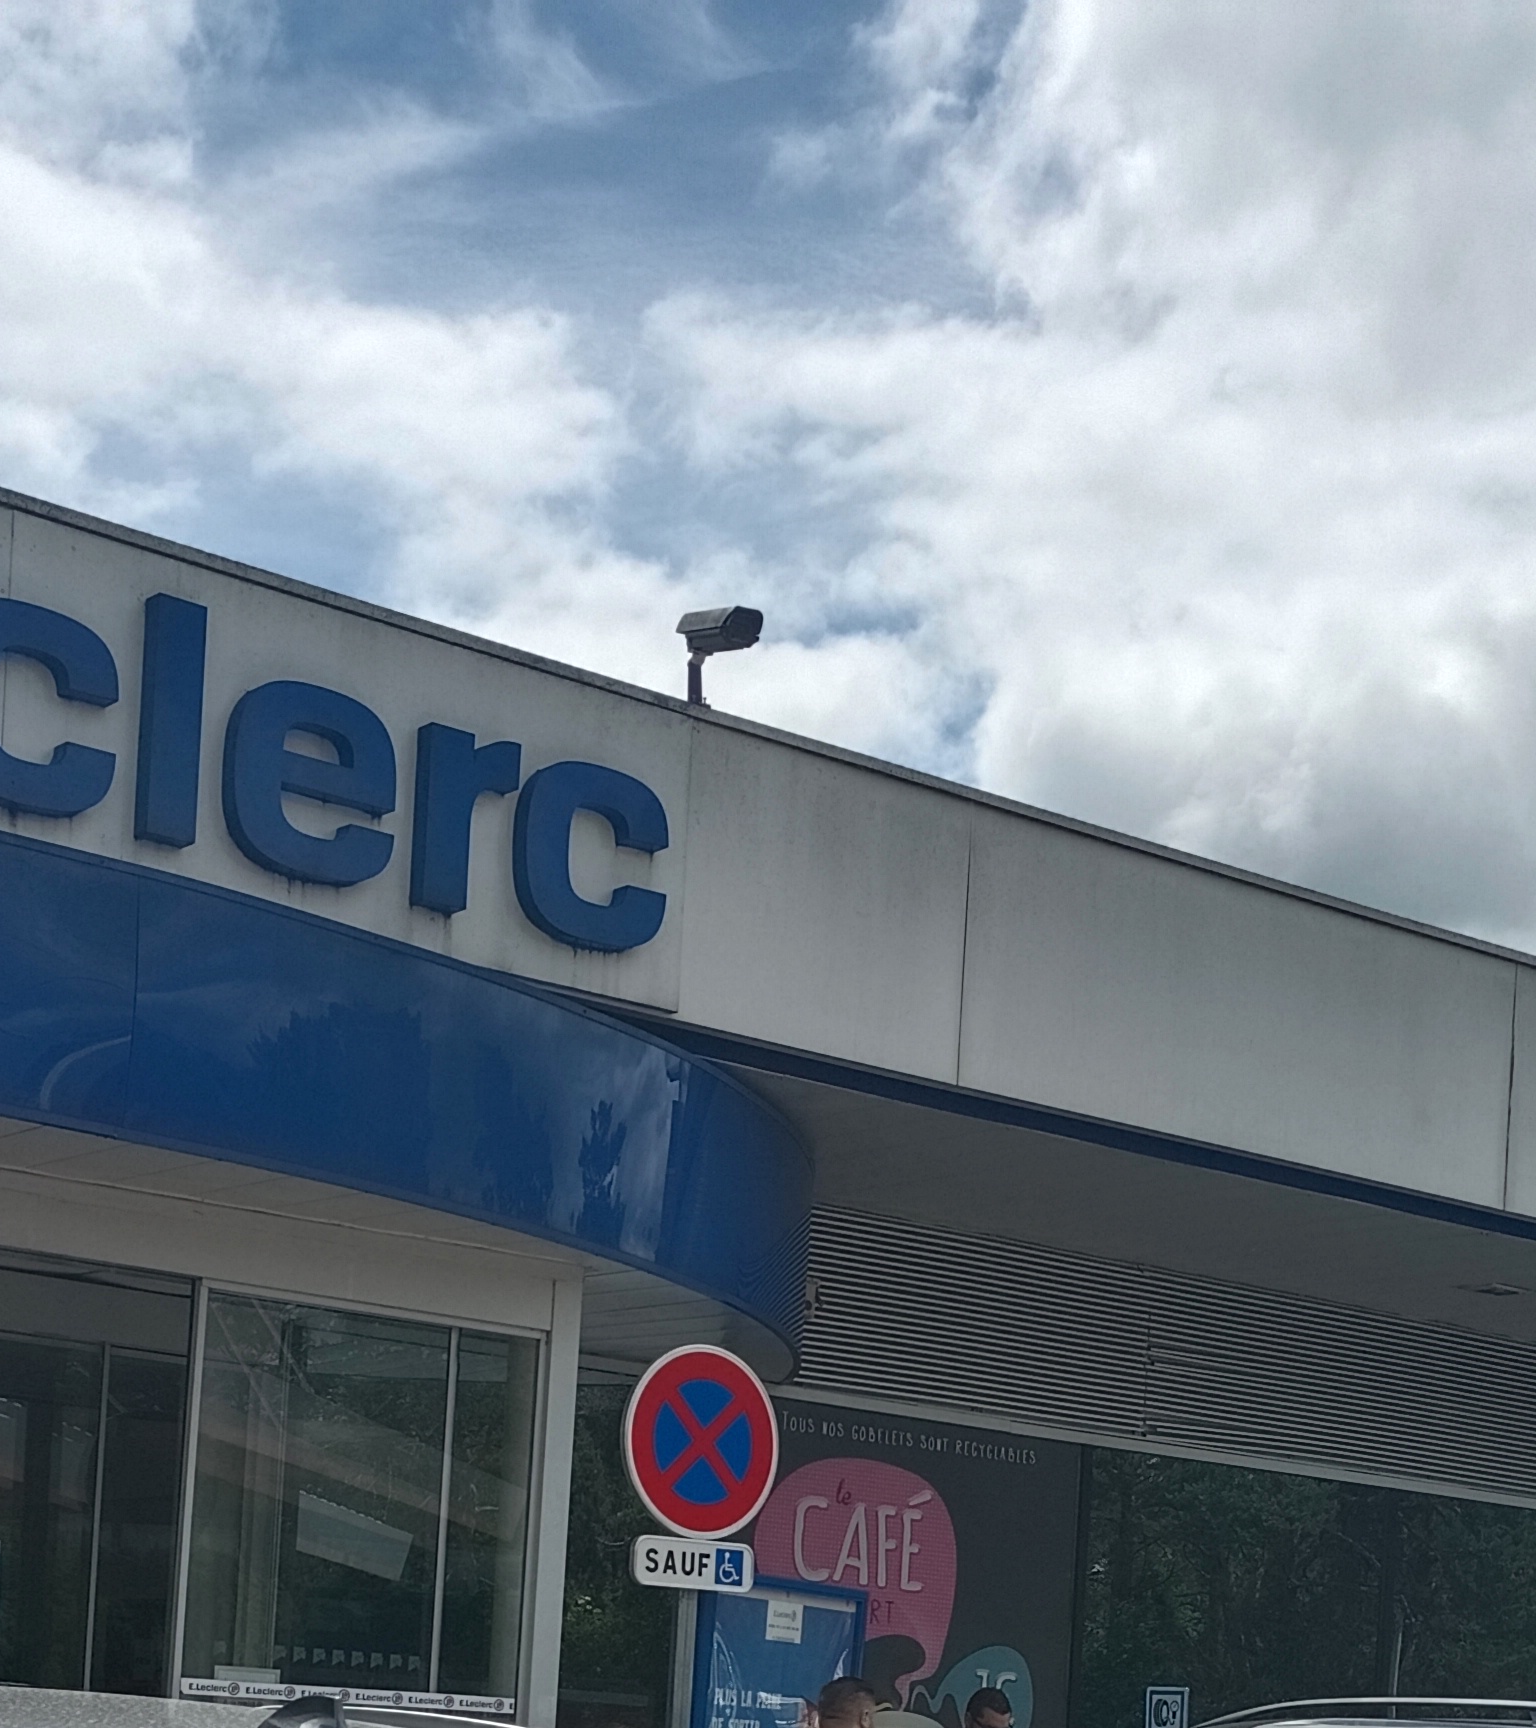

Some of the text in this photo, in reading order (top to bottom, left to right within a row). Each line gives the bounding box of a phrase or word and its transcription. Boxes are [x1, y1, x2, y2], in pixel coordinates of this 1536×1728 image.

[782, 1411, 1036, 1465] TOUS NOS GOBELETS SONT RECYCLABLES
[836, 1478, 852, 1505] le
[793, 1489, 934, 1592] CAFÉ
[645, 1547, 712, 1579] SAUF
[189, 1683, 227, 1694] E.Leclerc
[246, 1686, 283, 1697] E.Leclerc
[356, 1693, 392, 1703] E.Leclerc
[409, 1697, 443, 1706] E.Leclerc
[459, 1700, 493, 1710] E.Leclerc
[741, 1690, 752, 1707] LA
